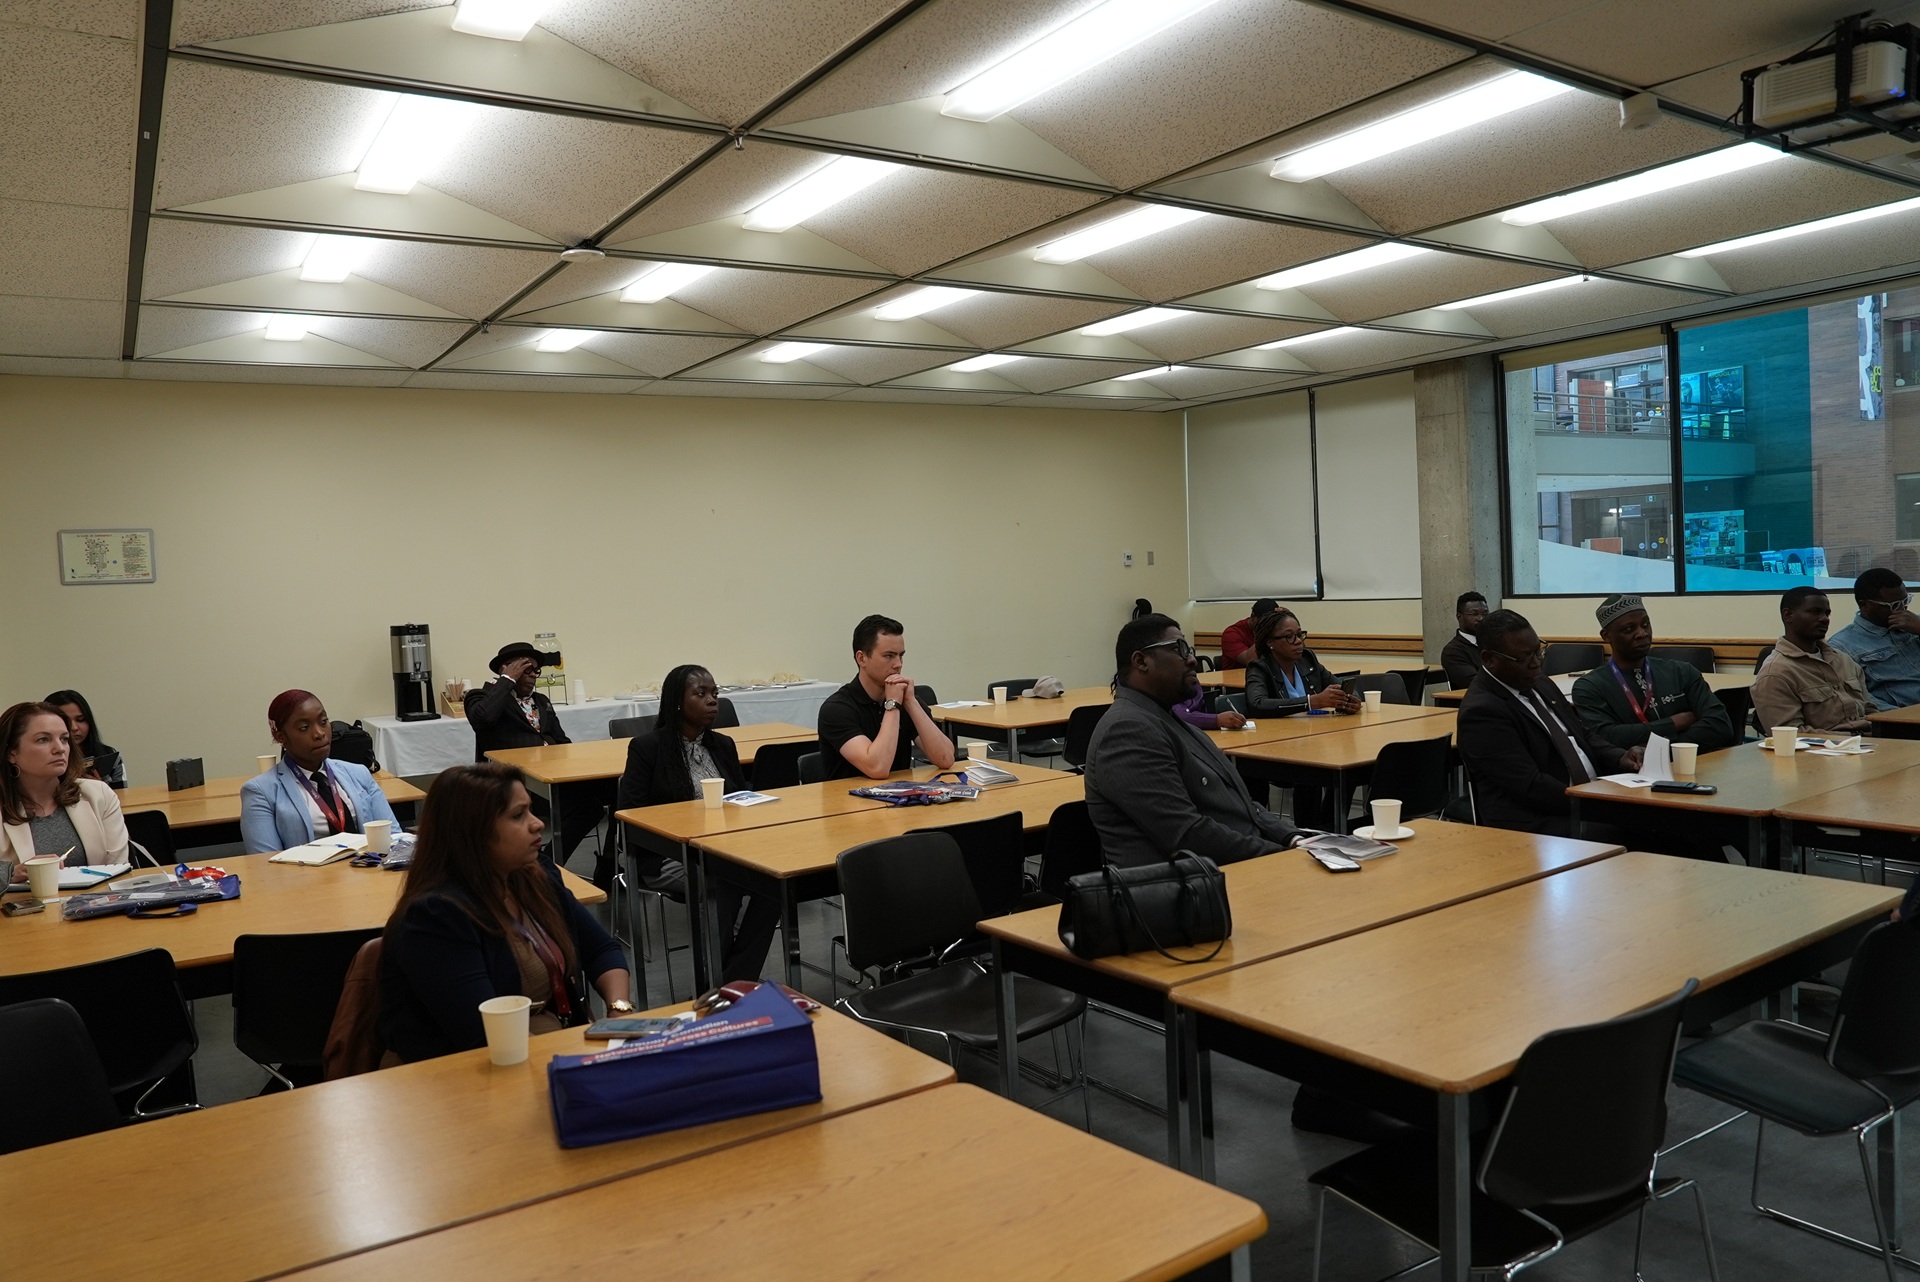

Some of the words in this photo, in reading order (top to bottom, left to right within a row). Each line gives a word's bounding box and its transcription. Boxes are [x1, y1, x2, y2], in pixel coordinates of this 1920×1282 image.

[1710, 370, 1739, 379] DOUGLAS
[594, 1042, 666, 1058] Networking
[666, 1030, 708, 1046] Across
[708, 1020, 760, 1035] Cultures
[622, 1036, 668, 1048] Proudly
[670, 1020, 729, 1038] Canadian
